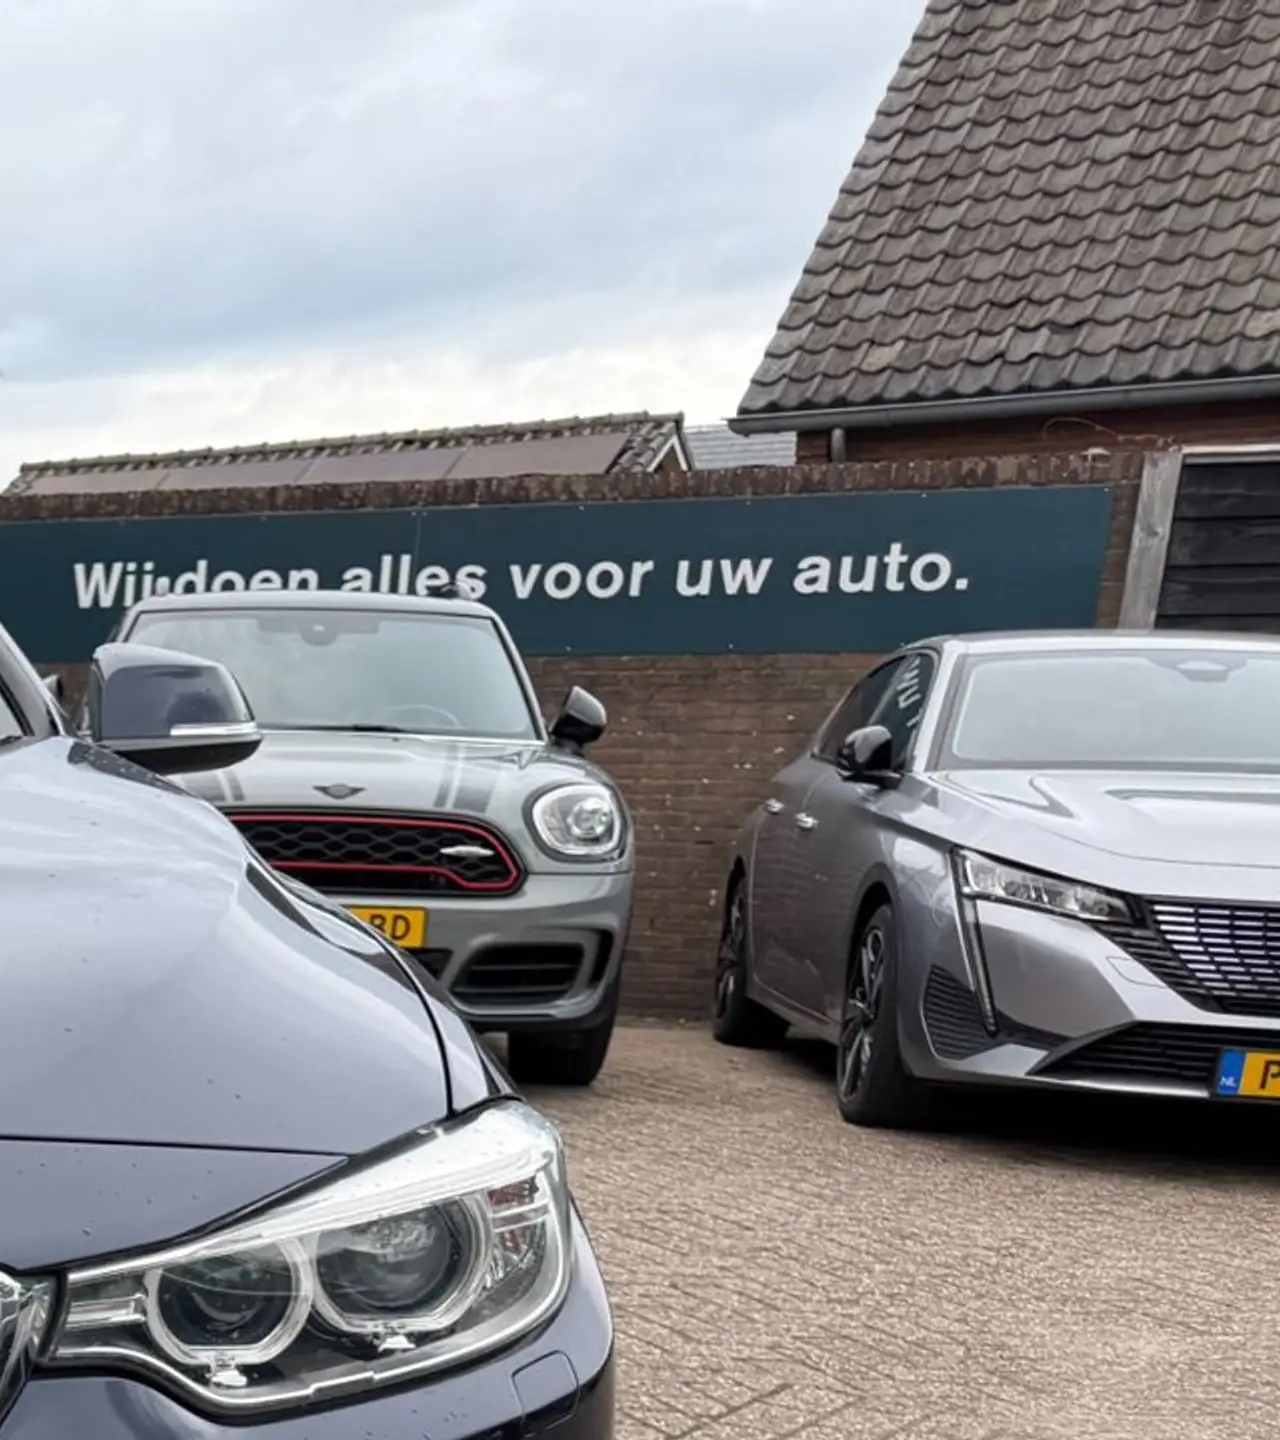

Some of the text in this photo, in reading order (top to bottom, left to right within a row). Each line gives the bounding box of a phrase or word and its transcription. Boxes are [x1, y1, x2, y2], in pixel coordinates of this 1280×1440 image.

[73, 541, 970, 609] Wij doen alles voor uw auto.
